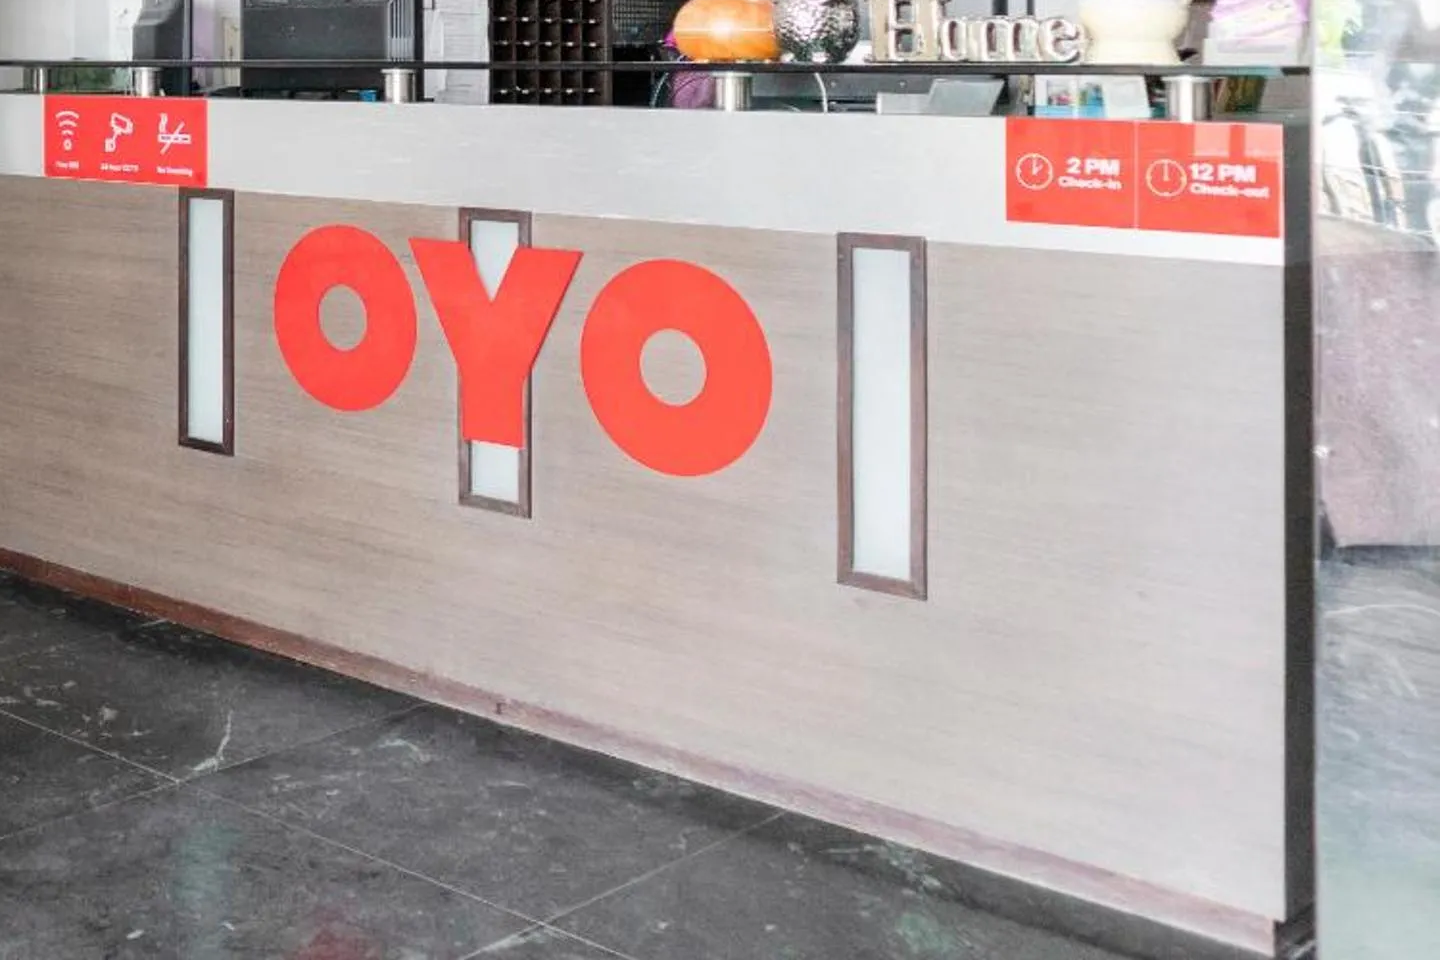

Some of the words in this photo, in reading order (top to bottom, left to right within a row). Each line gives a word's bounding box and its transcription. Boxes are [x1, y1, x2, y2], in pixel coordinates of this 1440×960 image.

[1066, 157, 1082, 175] 2
[1085, 158, 1121, 177] PM
[1189, 162, 1215, 182] 12
[1218, 164, 1257, 184] PM
[1058, 175, 1123, 191] Check-in
[273, 224, 773, 478] OYO
